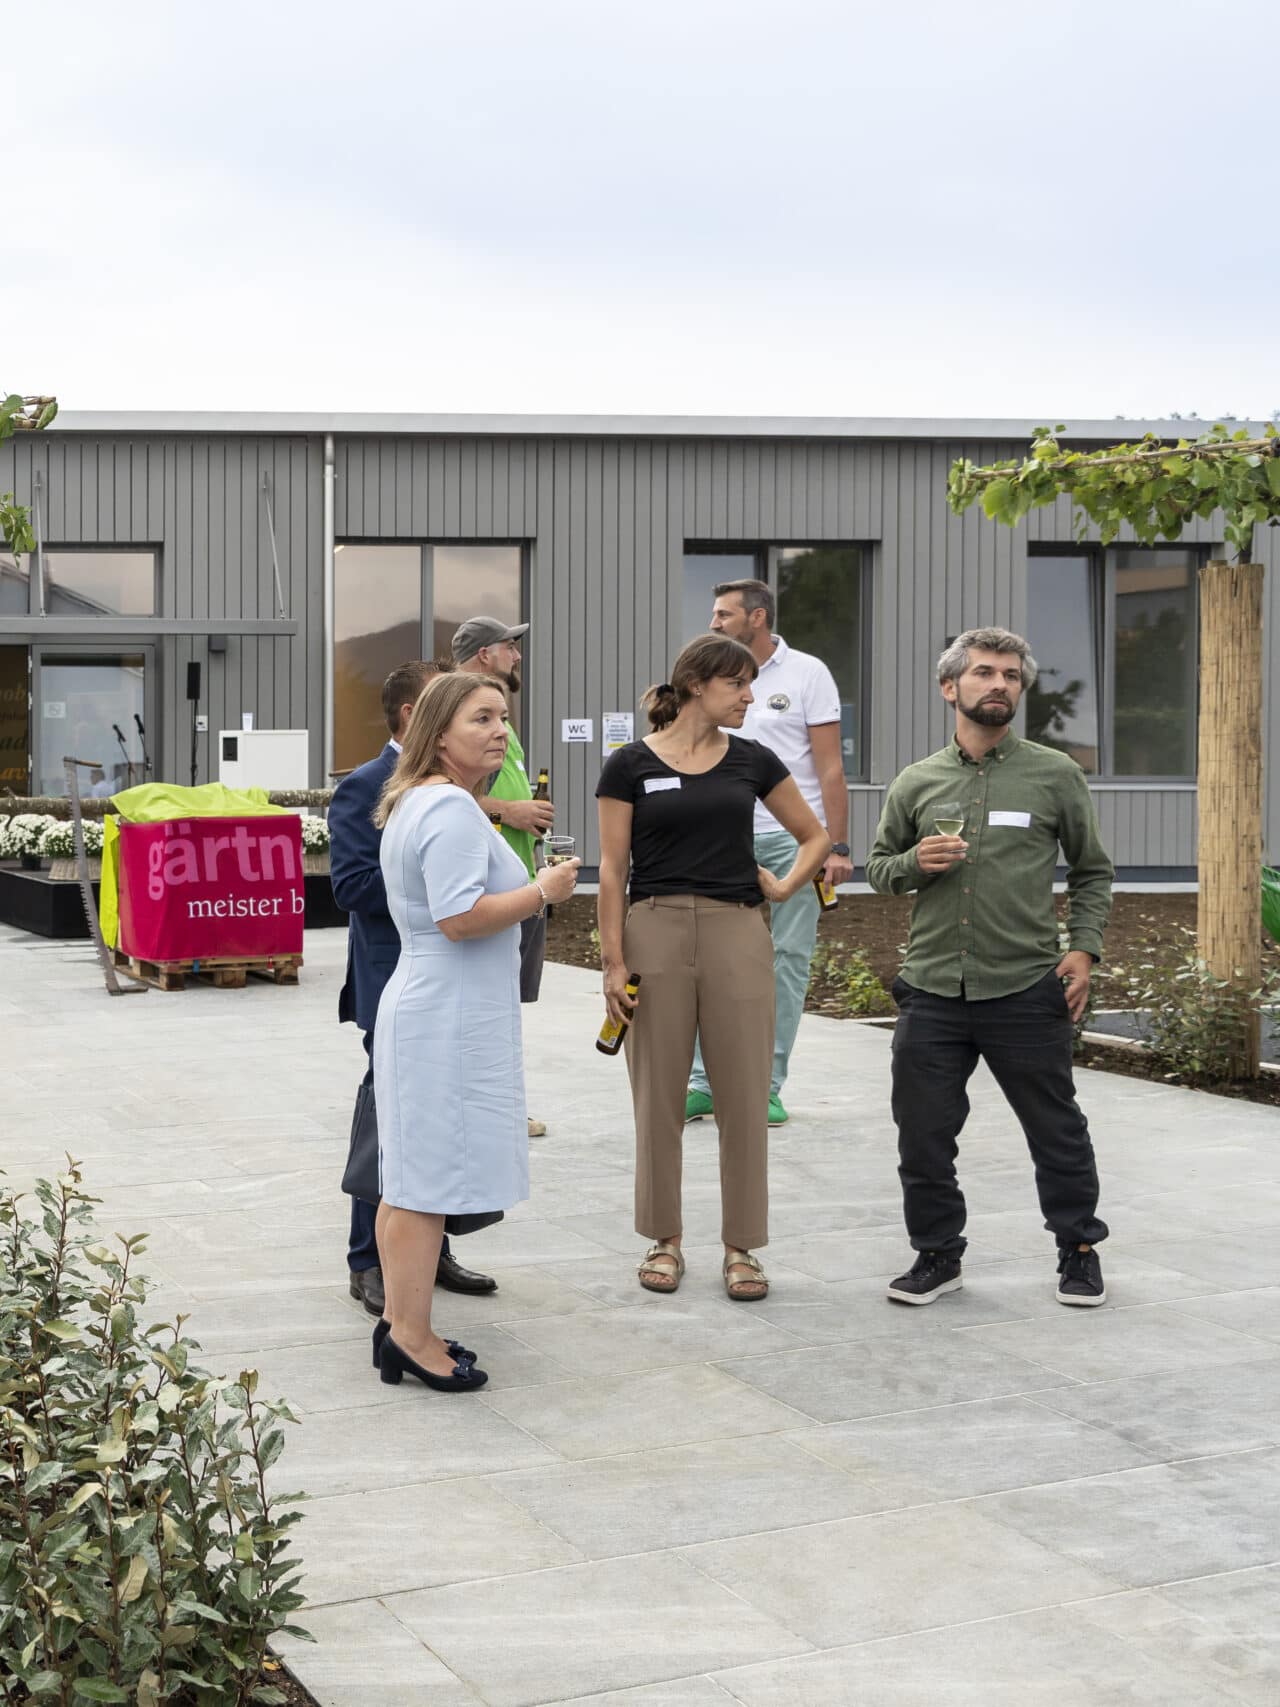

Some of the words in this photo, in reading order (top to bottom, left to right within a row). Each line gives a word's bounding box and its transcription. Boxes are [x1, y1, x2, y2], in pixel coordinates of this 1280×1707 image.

[568, 724, 586, 734] WC
[148, 822, 303, 900] gärtn
[187, 893, 283, 918] meister
